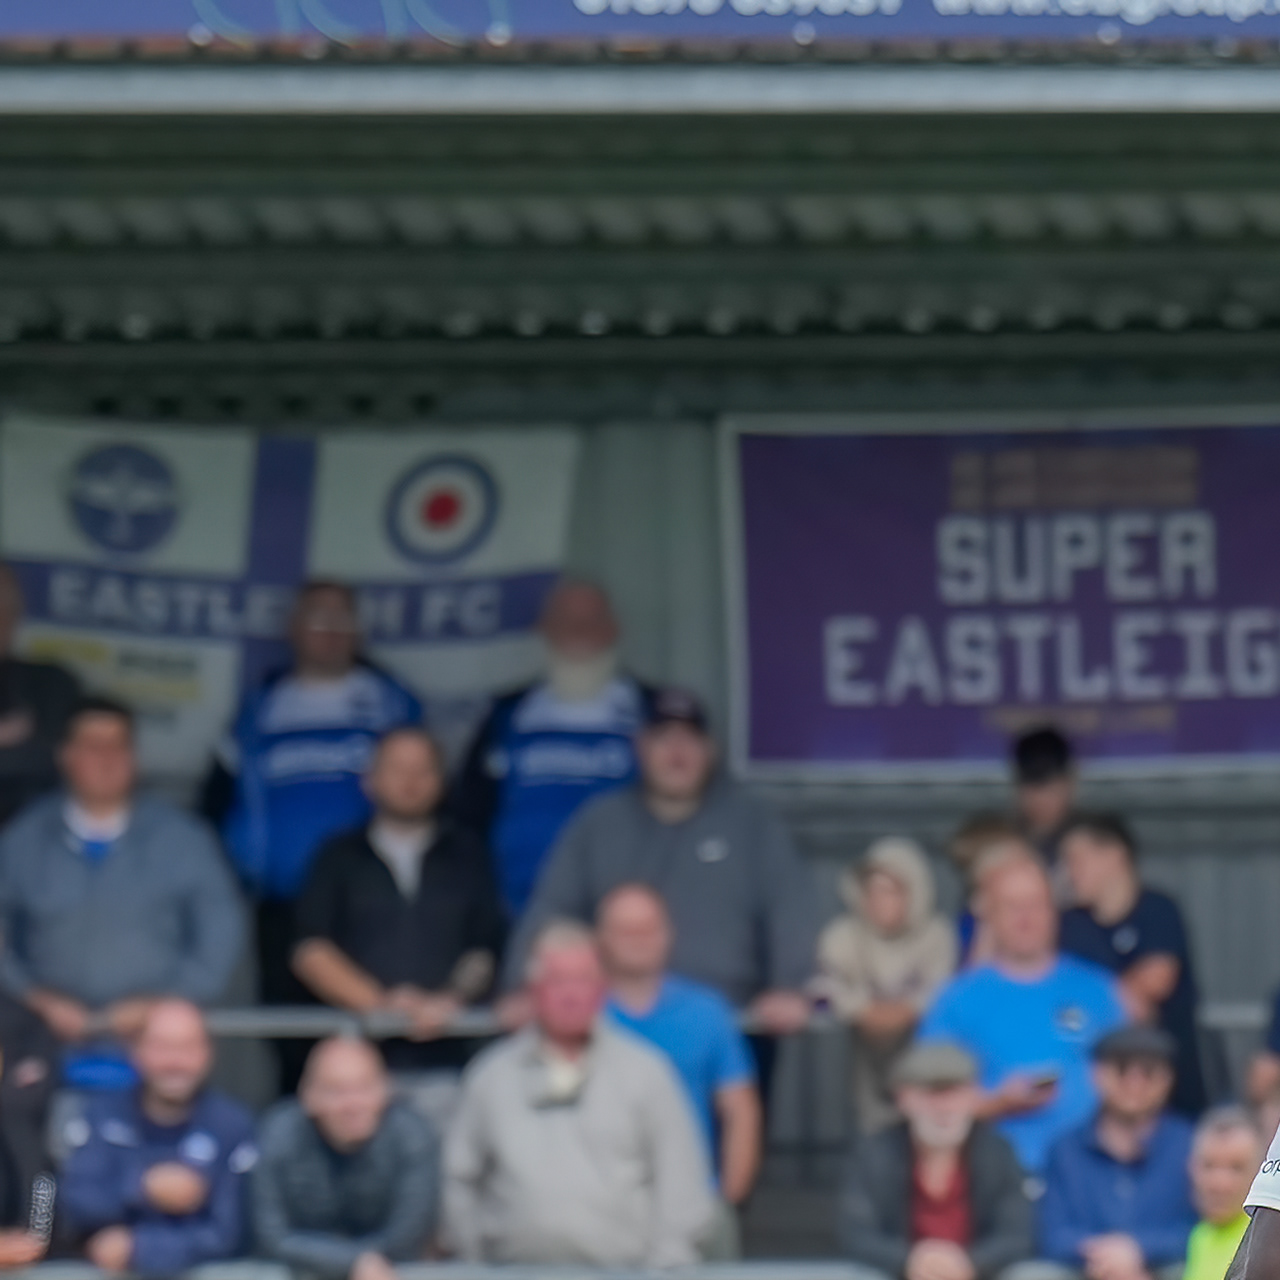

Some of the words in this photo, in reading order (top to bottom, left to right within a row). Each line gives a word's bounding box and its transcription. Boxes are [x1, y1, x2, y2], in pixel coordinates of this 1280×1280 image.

[936, 509, 1217, 603] SUPER
[49, 570, 404, 637] EASTLEH
[419, 583, 502, 632] FC
